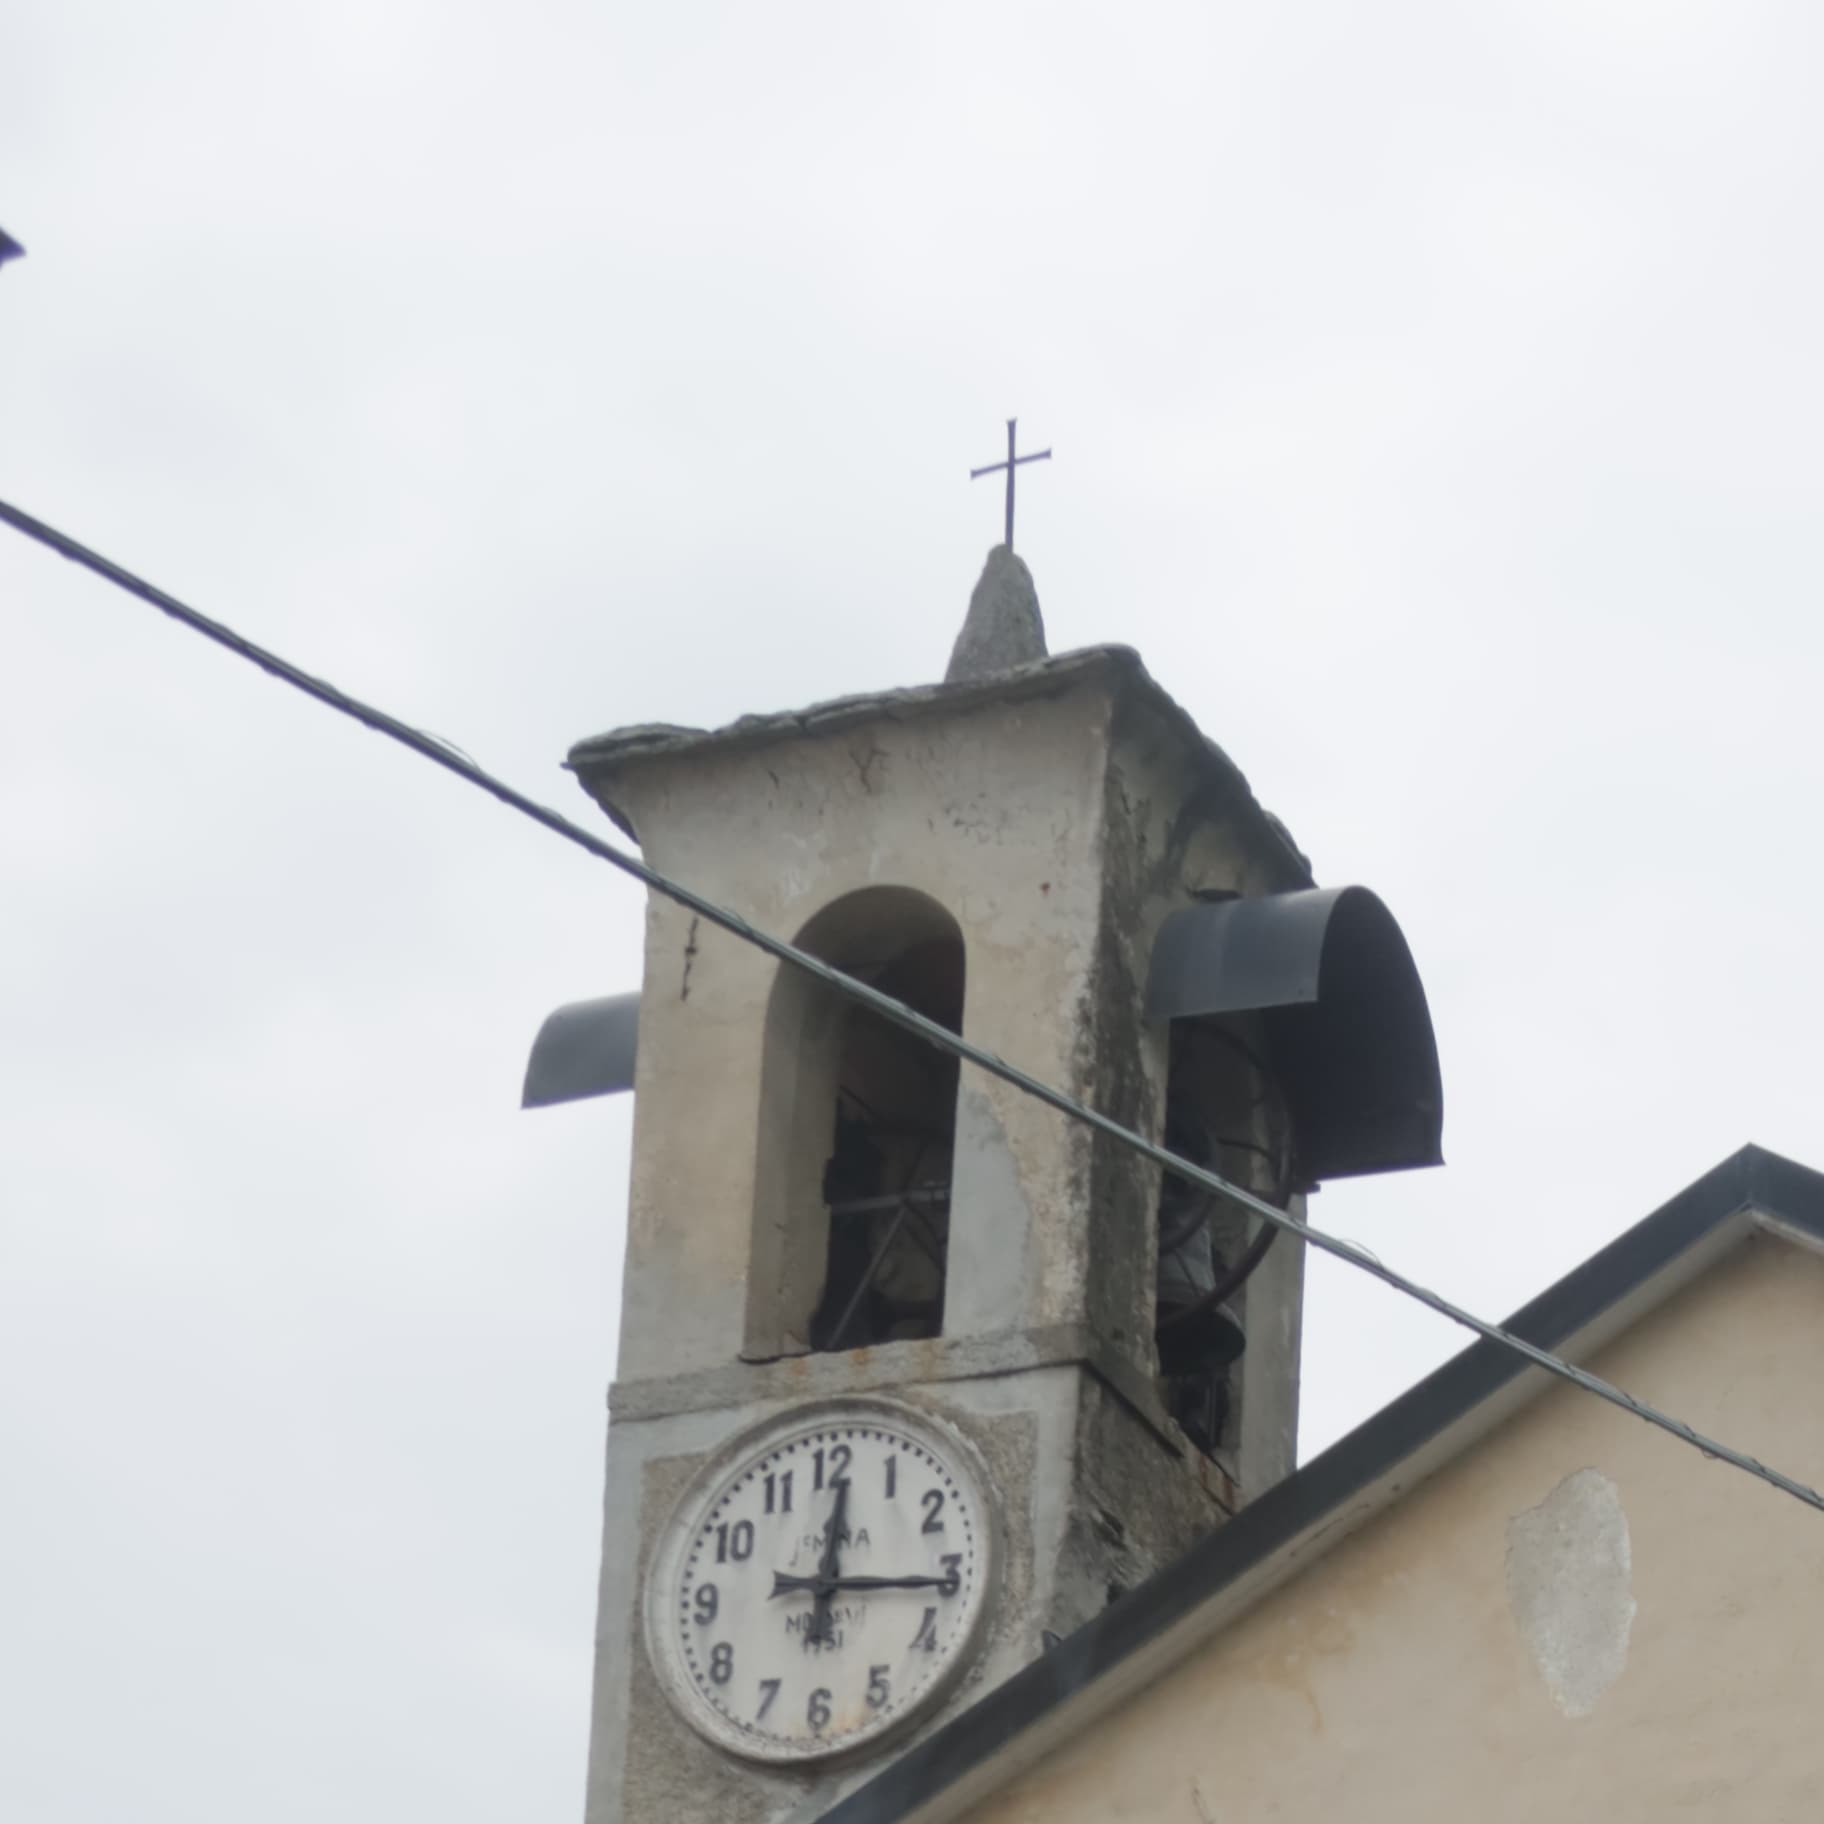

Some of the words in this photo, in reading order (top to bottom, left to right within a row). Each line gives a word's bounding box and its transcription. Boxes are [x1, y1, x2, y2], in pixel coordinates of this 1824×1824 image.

[812, 1444, 852, 1491] 12
[884, 1454, 896, 1499] 1
[764, 1470, 793, 1514] 11
[921, 1488, 944, 1534] 2
[716, 1519, 754, 1564] 10
[938, 1553, 963, 1598] 3
[694, 1582, 719, 1626] 9
[908, 1606, 937, 1651] 4
[709, 1641, 733, 1685] 8
[756, 1678, 782, 1721] 7
[807, 1687, 832, 1730] 6
[866, 1664, 890, 1709] 5
